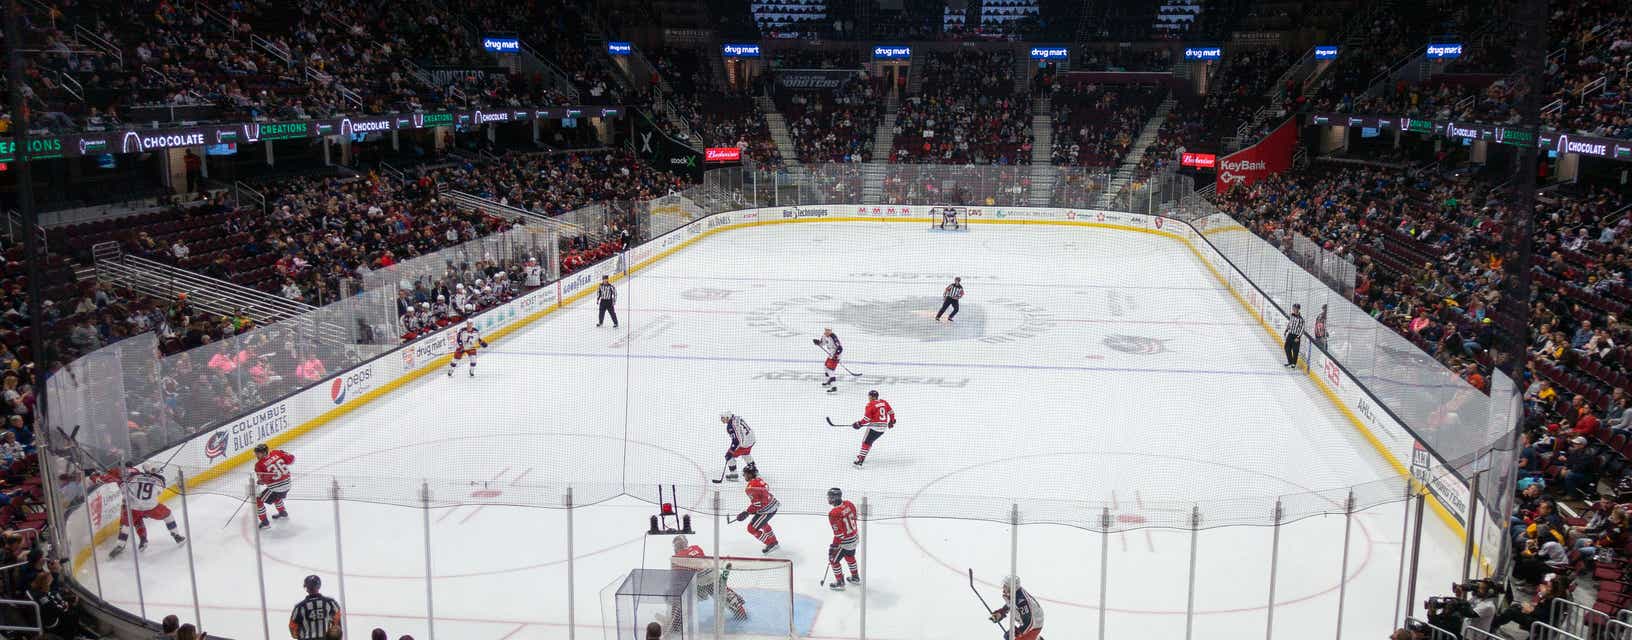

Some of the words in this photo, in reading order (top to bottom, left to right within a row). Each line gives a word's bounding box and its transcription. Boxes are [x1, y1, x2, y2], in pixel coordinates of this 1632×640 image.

[485, 38, 502, 50] drug
[502, 40, 520, 49] mart
[724, 45, 741, 55] drug
[875, 47, 892, 57] drug
[1031, 48, 1048, 57] drug
[1185, 49, 1202, 58] drug
[1427, 46, 1444, 56] drug
[1444, 45, 1463, 54] mart
[482, 113, 508, 122] CHOCOLATE
[260, 123, 308, 135] CREATIONS
[353, 121, 391, 132] CHOCOLATE
[1453, 127, 1477, 139] CHOCOLATE
[144, 134, 205, 149] CHOCOLATE
[1568, 141, 1606, 156] CHOCOLATE
[1221, 160, 1266, 172] KeyBank
[416, 344, 432, 358] drug
[432, 337, 447, 352] mart
[346, 364, 374, 388] pepsi
[232, 404, 287, 435] COLUMBUS
[879, 406, 886, 421] 9
[234, 429, 255, 452] BLUE
[257, 415, 290, 445] JACKETS
[267, 458, 288, 481] 36
[137, 482, 154, 500] 19
[309, 607, 325, 620] 45
